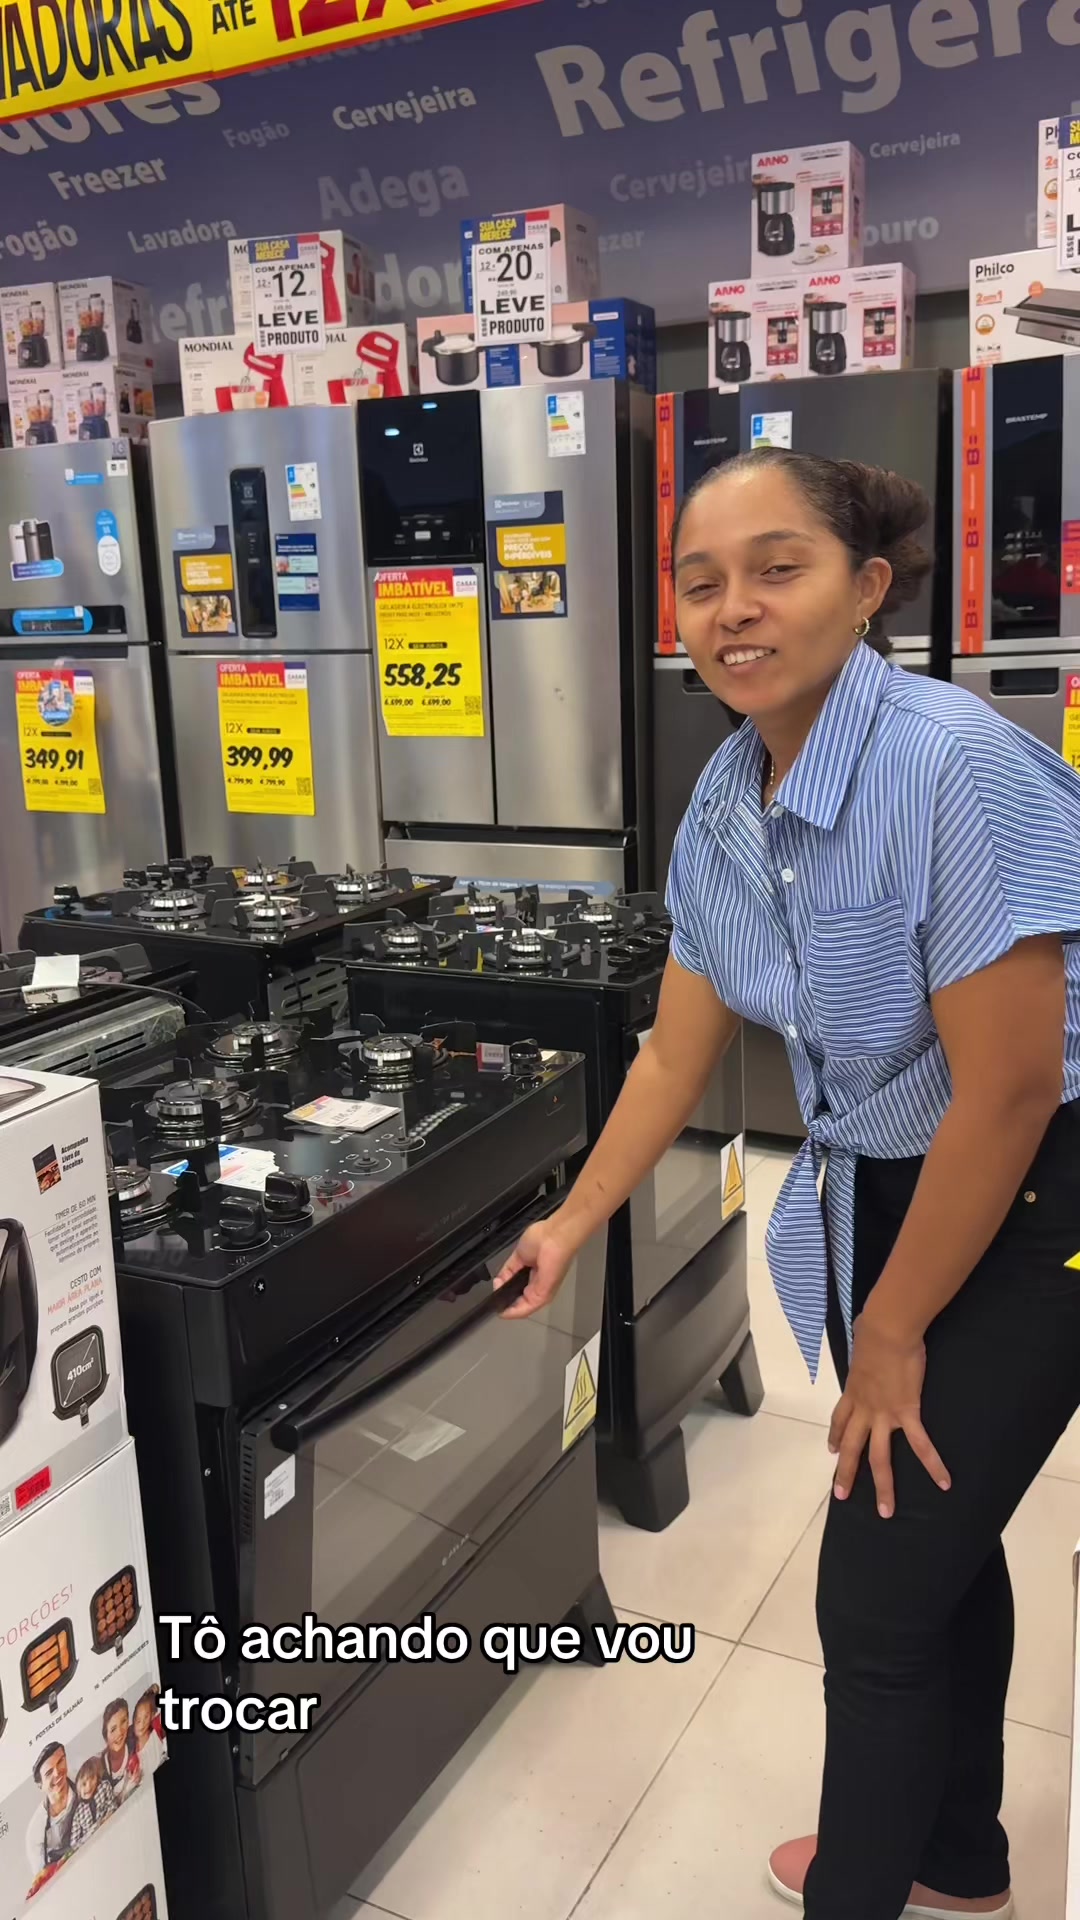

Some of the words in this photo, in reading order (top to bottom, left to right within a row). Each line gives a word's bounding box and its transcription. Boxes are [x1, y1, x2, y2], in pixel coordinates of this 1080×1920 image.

[332, 85, 477, 130] Cervejeira
[222, 121, 290, 148] Fogão
[869, 131, 961, 159] Cervejeira
[757, 155, 789, 167] ARNO
[48, 157, 168, 200] Freezer
[610, 154, 752, 203] Cervejeir
[317, 163, 470, 222] Adega
[496, 217, 517, 229] CASA
[127, 218, 237, 254] Lavadora
[596, 227, 645, 254] ezer
[478, 247, 501, 255] COM
[503, 242, 544, 253] APENAS
[278, 262, 316, 271] APENAS
[496, 250, 532, 282] 20
[975, 263, 1015, 278] Philco
[272, 270, 307, 298] 12
[809, 274, 841, 287] ARNO
[715, 285, 745, 296] ARNO
[480, 295, 545, 316] LEVE
[258, 309, 319, 328] LEVE
[489, 317, 545, 336] PRODUTO
[184, 341, 234, 353] MONDIAL
[267, 330, 319, 346] PRODUTO
[378, 579, 451, 598] IMBATÍVEL
[384, 638, 405, 650] 12X
[220, 671, 283, 687] IMBATÍVEL
[384, 662, 462, 690] 558,25
[23, 727, 38, 737] 12X
[225, 723, 243, 734] 12X
[25, 748, 84, 772] 349,91
[226, 745, 293, 770] 399,99
[60, 1136, 89, 1155] Acompanha
[62, 1157, 84, 1173] Receitas
[70, 1272, 89, 1290] CESTO
[89, 1265, 102, 1279] COM
[35, 1720, 56, 1741] POSTAS
[63, 1696, 84, 1718] SALMÃO
